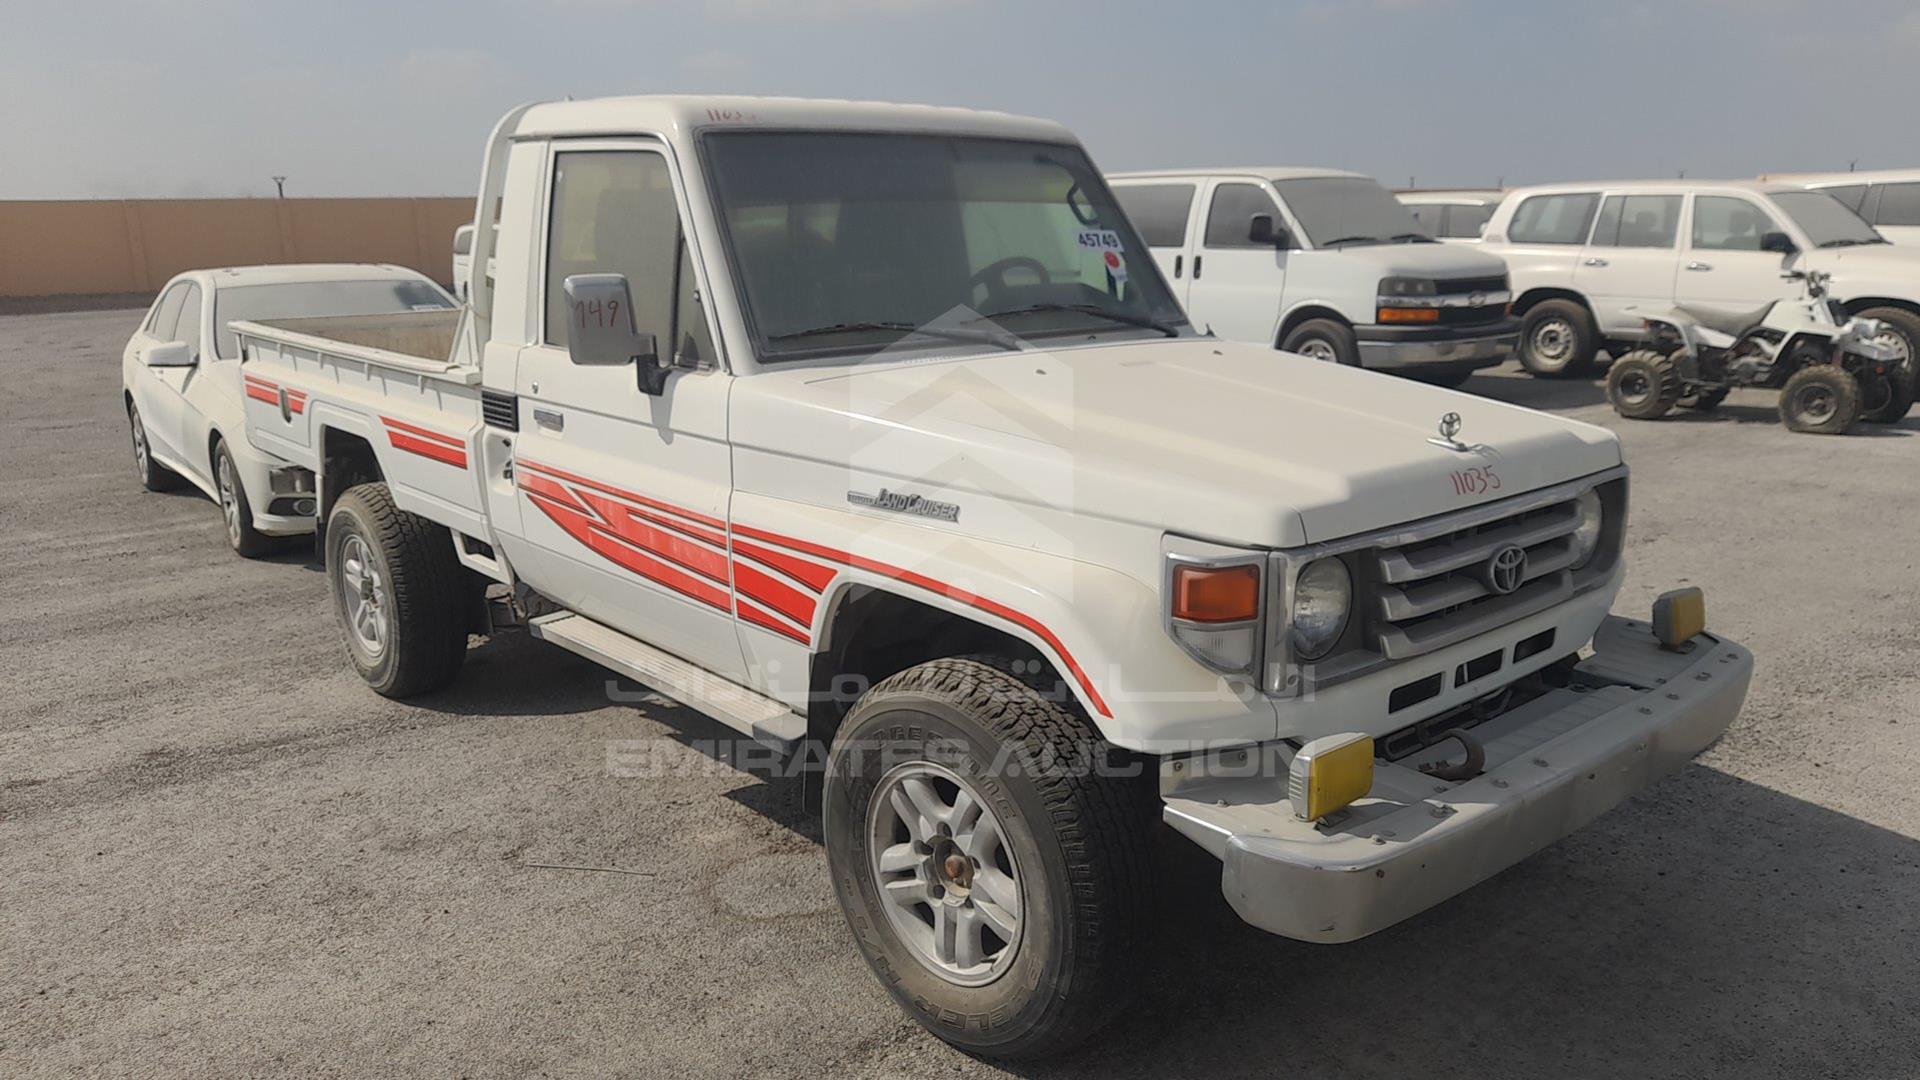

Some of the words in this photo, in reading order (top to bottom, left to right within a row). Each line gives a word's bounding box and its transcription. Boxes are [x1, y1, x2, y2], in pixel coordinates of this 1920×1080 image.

[1078, 232, 1119, 248] 45749
[1450, 464, 1501, 495] 11035
[878, 488, 909, 512] LAND
[906, 494, 960, 523] CRUISER
